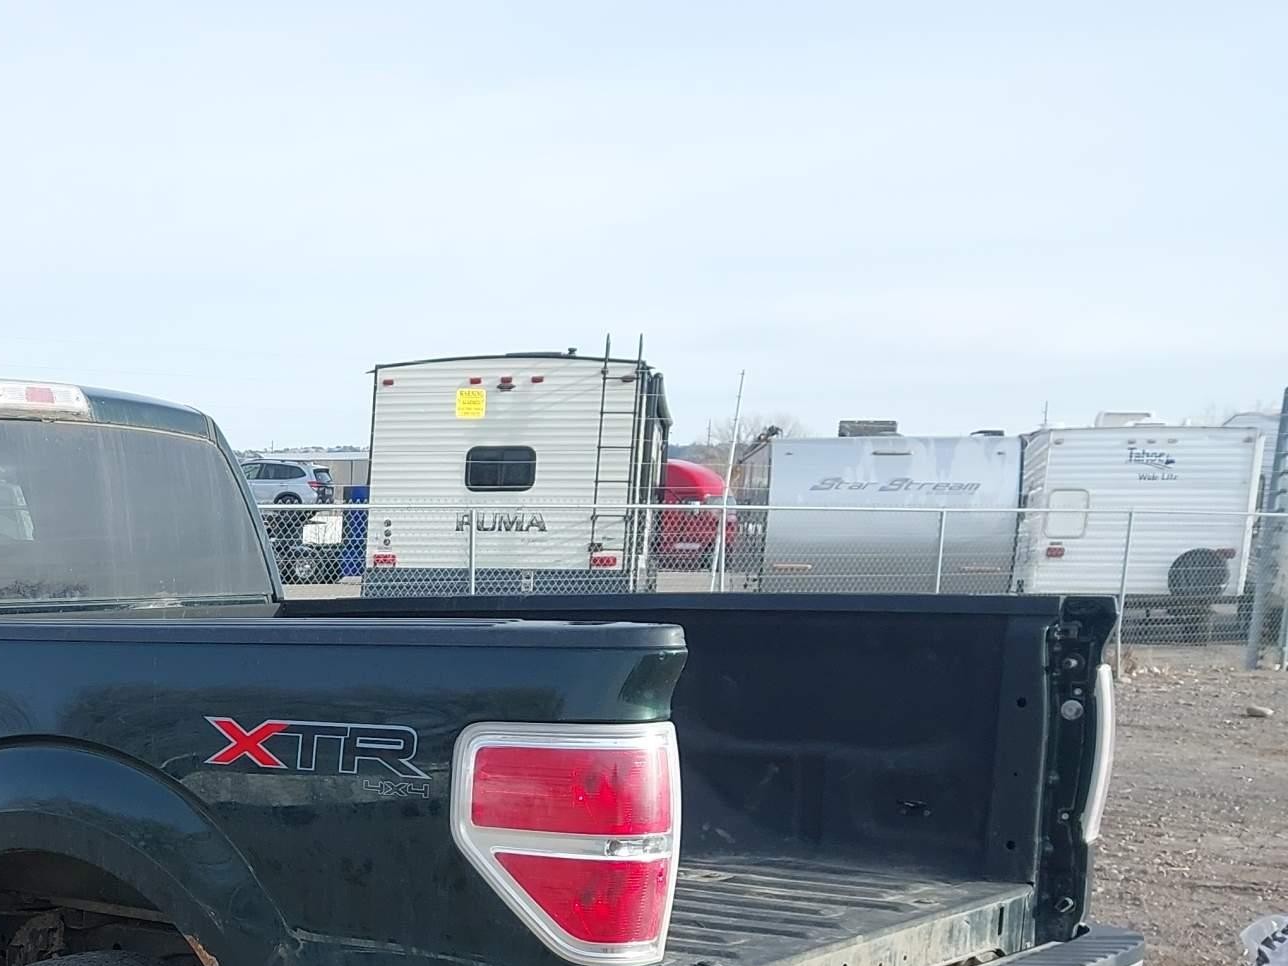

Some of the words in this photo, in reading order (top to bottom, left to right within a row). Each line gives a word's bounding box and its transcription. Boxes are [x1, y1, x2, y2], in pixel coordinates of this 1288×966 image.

[809, 477, 878, 491] Star
[878, 477, 981, 493] Stream
[203, 715, 433, 780] XTR
